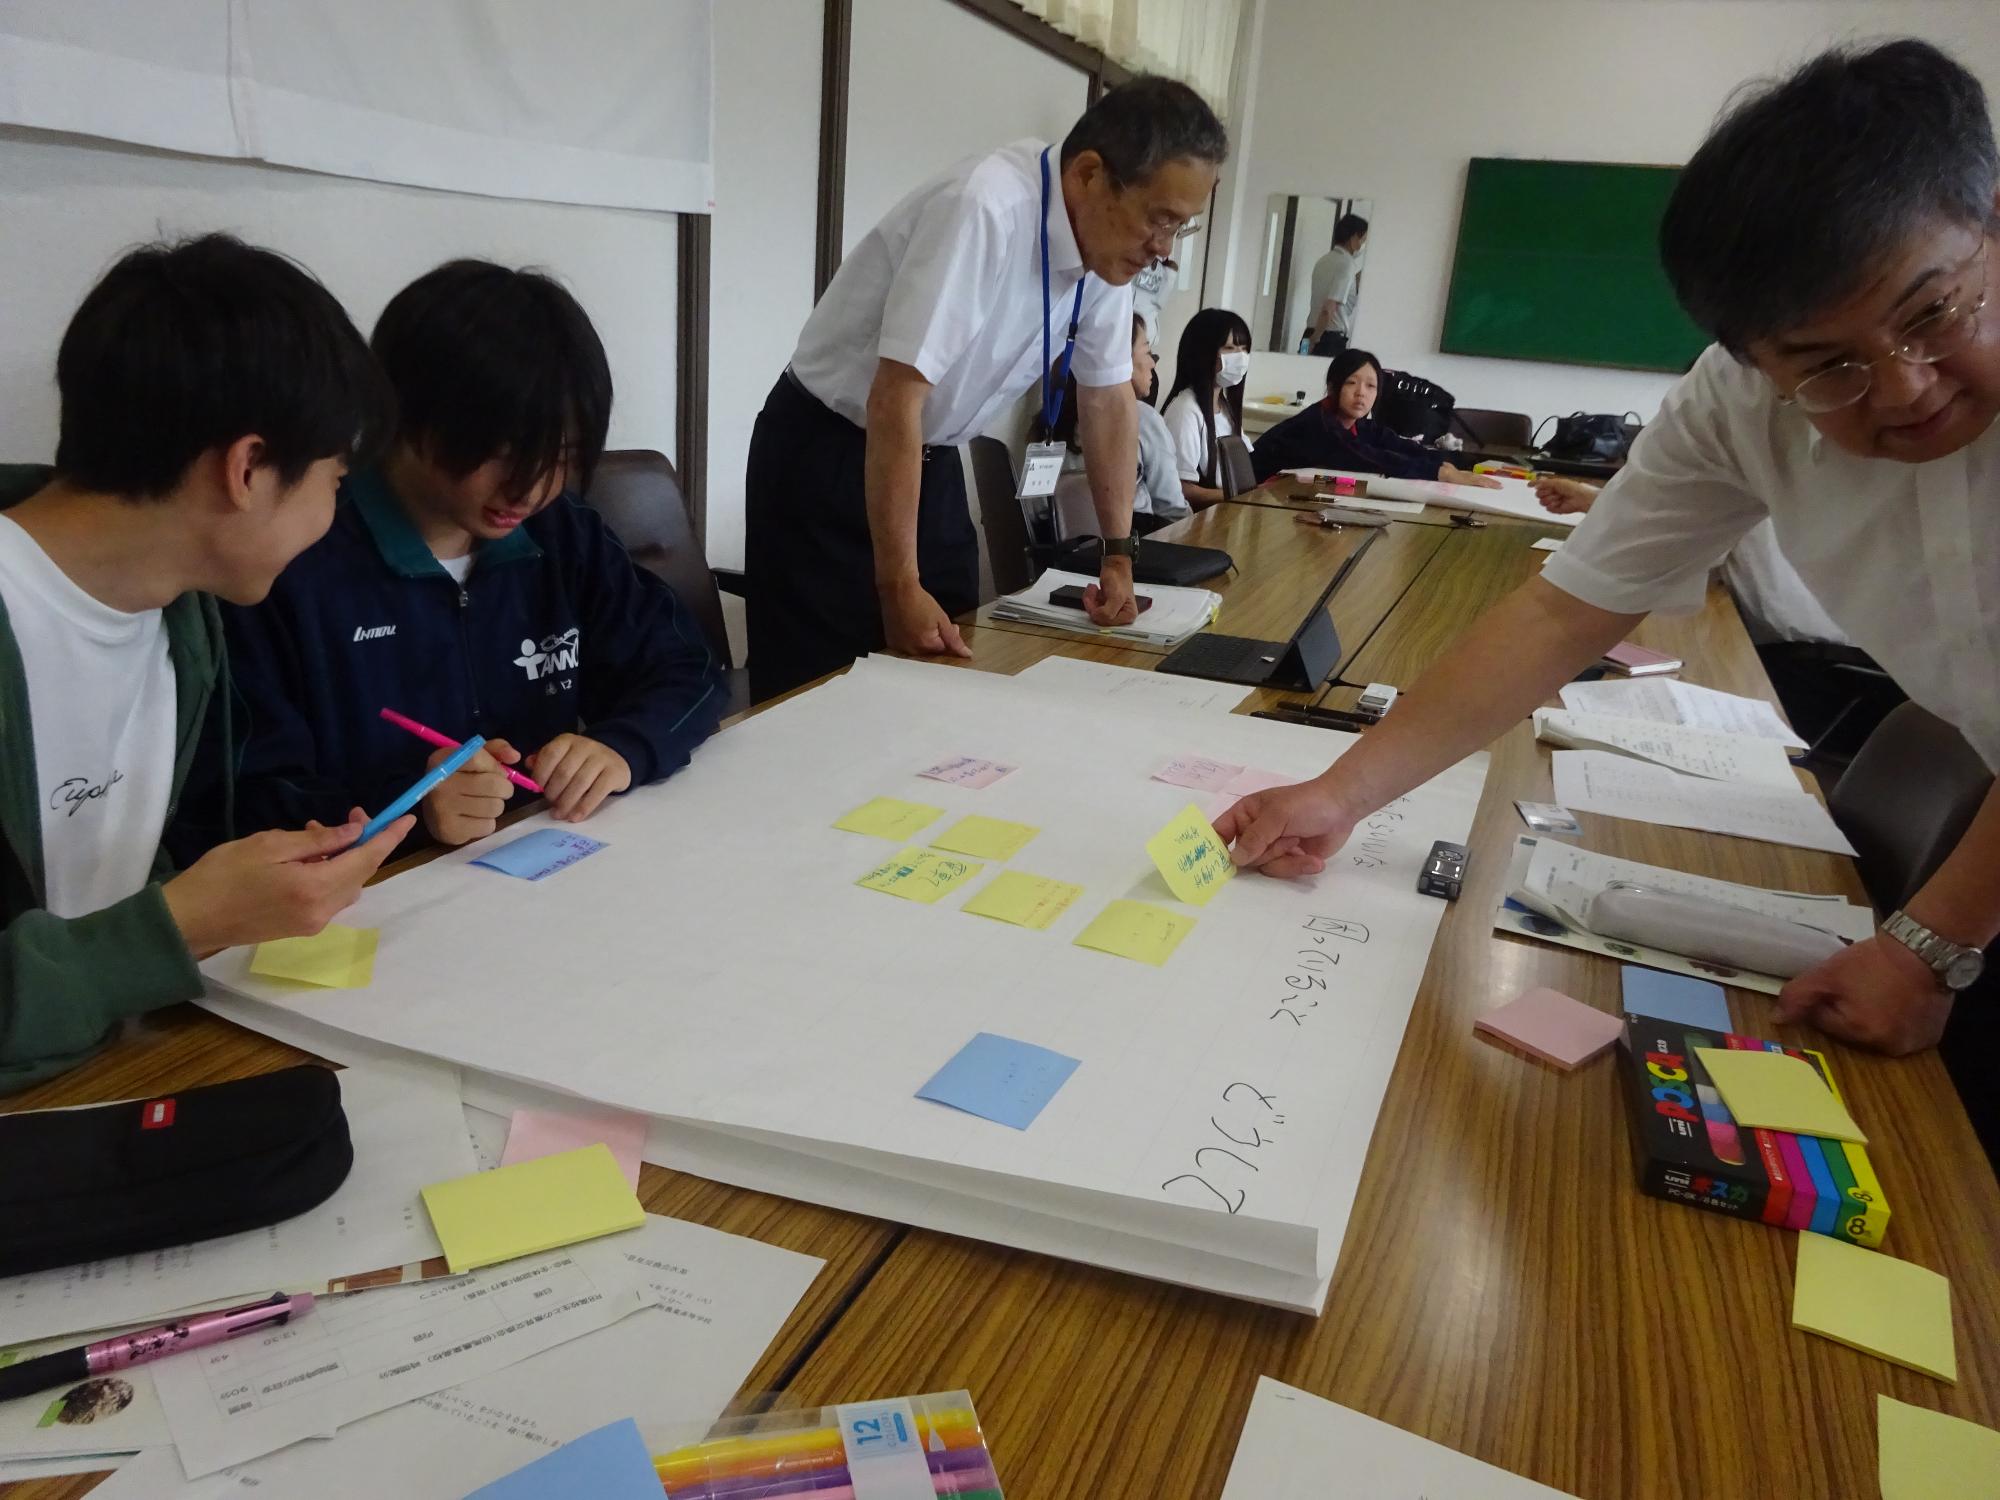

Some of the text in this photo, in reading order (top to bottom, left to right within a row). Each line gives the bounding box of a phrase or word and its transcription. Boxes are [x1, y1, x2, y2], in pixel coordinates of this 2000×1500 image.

[1645, 1051, 1698, 1123] POSCA
[1162, 1082, 1285, 1215] どうして
[853, 1418, 882, 1445] 12
